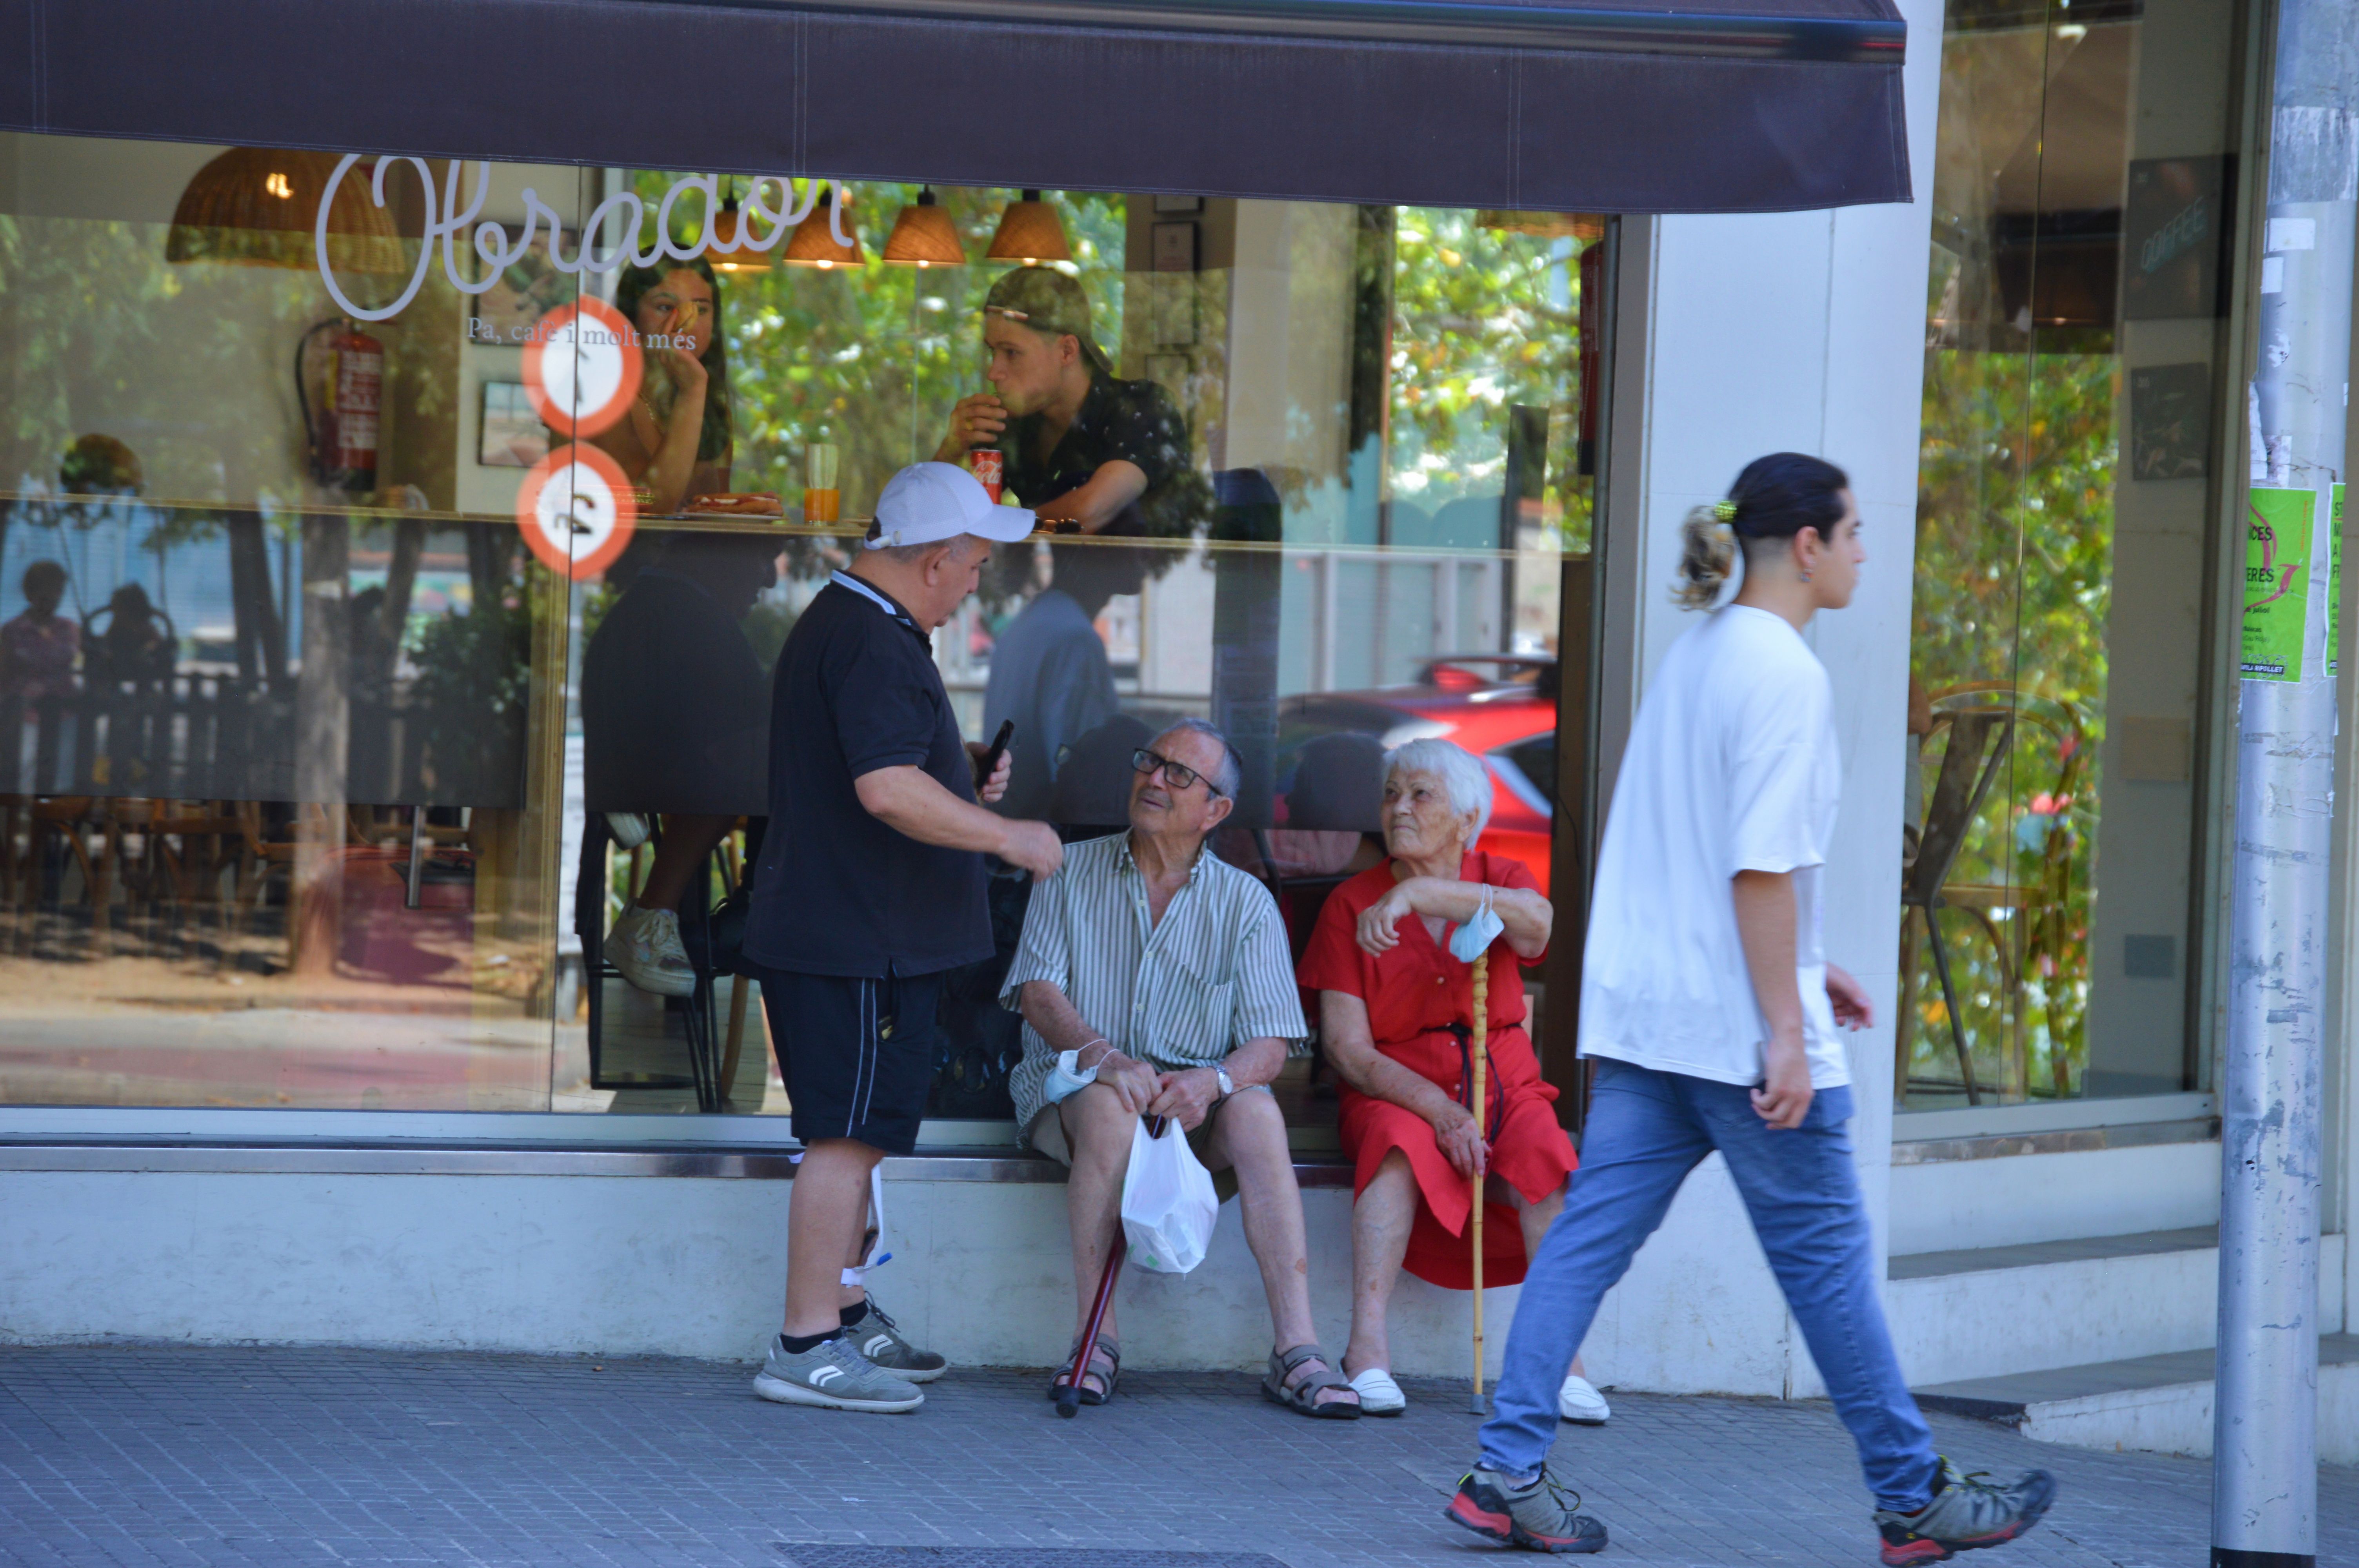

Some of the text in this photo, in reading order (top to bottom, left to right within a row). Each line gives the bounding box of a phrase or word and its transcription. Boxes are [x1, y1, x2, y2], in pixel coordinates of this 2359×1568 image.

[2141, 195, 2205, 270] COFFEE
[468, 318, 696, 349] Pa, cafè i molt més
